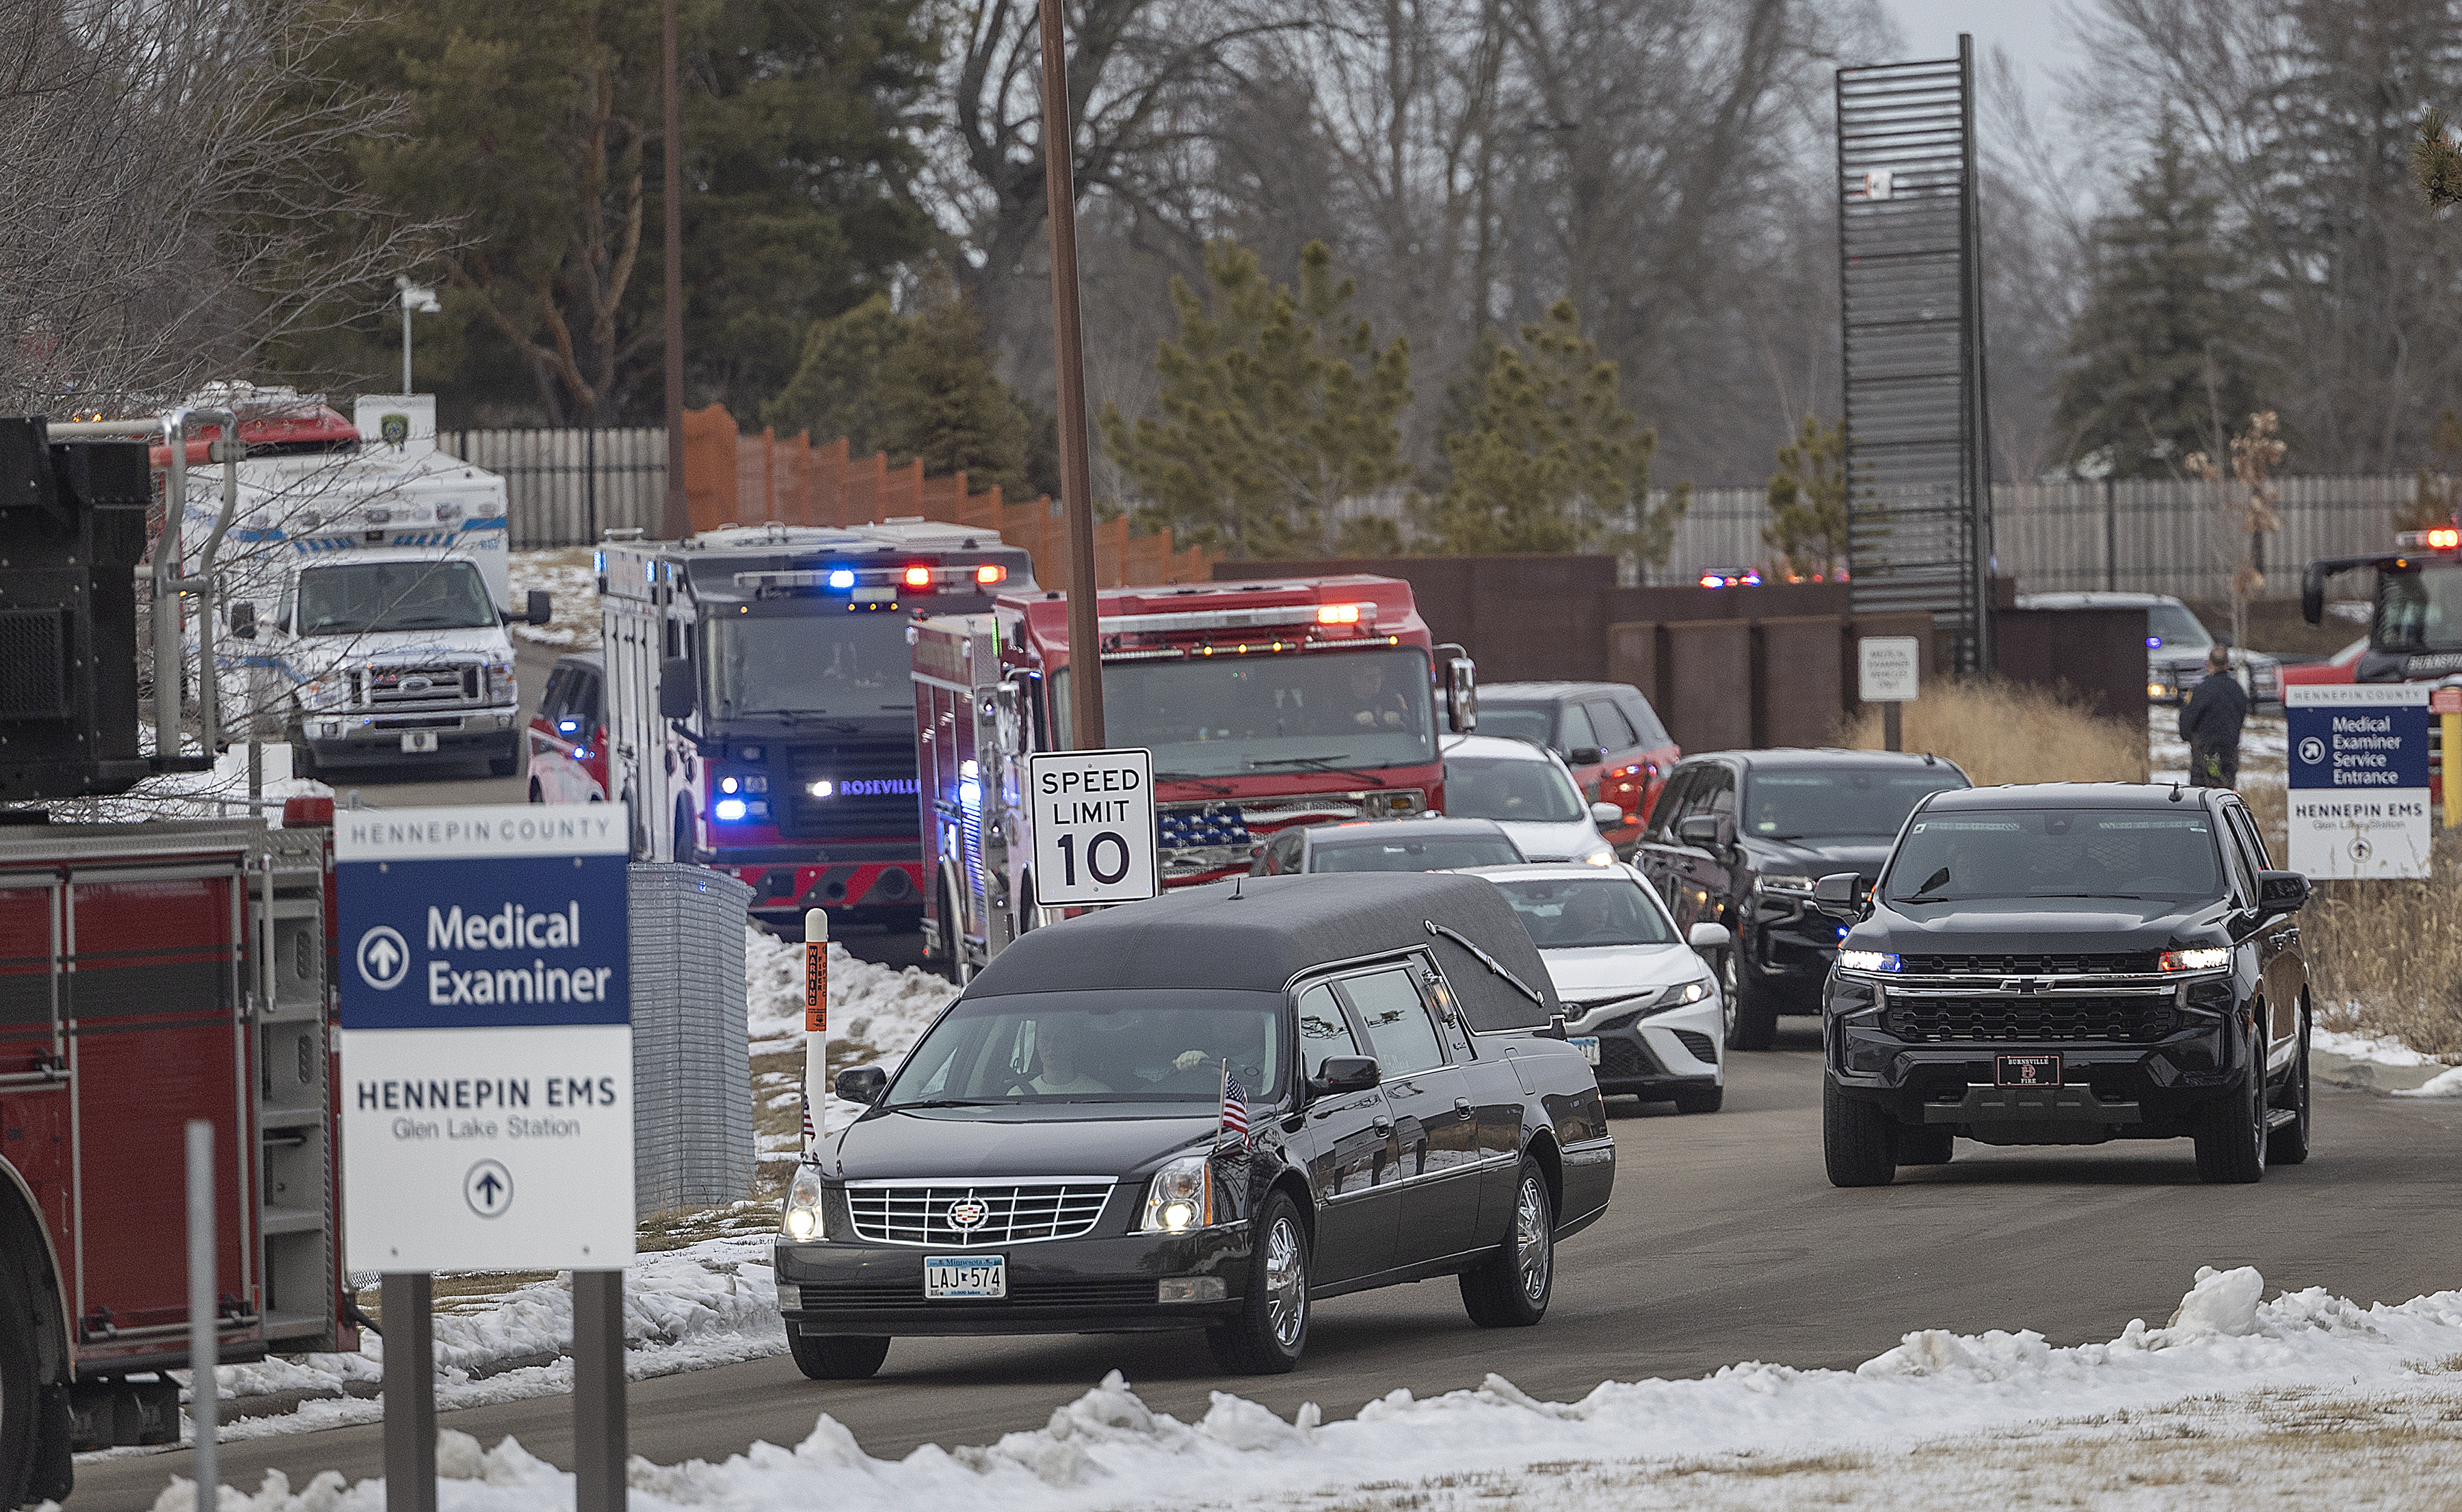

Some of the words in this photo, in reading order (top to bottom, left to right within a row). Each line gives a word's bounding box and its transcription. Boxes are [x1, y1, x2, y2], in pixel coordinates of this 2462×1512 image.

[2294, 690, 2363, 701] HENNEPIN
[2332, 715, 2391, 732] Medical
[2333, 734, 2403, 750] Examiner
[2333, 751, 2387, 767] Service
[1042, 769, 1139, 794] SPEED
[2333, 769, 2399, 785] Entrance
[1054, 800, 1130, 825] LIMIT
[2296, 803, 2382, 818] HENNEPIN
[2388, 802, 2423, 817] EMS
[351, 821, 490, 845] HENNEPIN
[499, 819, 610, 840] COUNTY
[1057, 832, 1130, 886] 10
[427, 899, 580, 951] Medical
[428, 958, 613, 1006] Examiner
[809, 949, 817, 1005] WARNING
[359, 1078, 529, 1109] HENNEPIN
[547, 1076, 616, 1106] EMS
[392, 1116, 440, 1141] Glen
[447, 1117, 498, 1139] Lake
[507, 1114, 581, 1139] Station
[930, 1268, 959, 1288] LAJ
[971, 1267, 1000, 1287] 574
